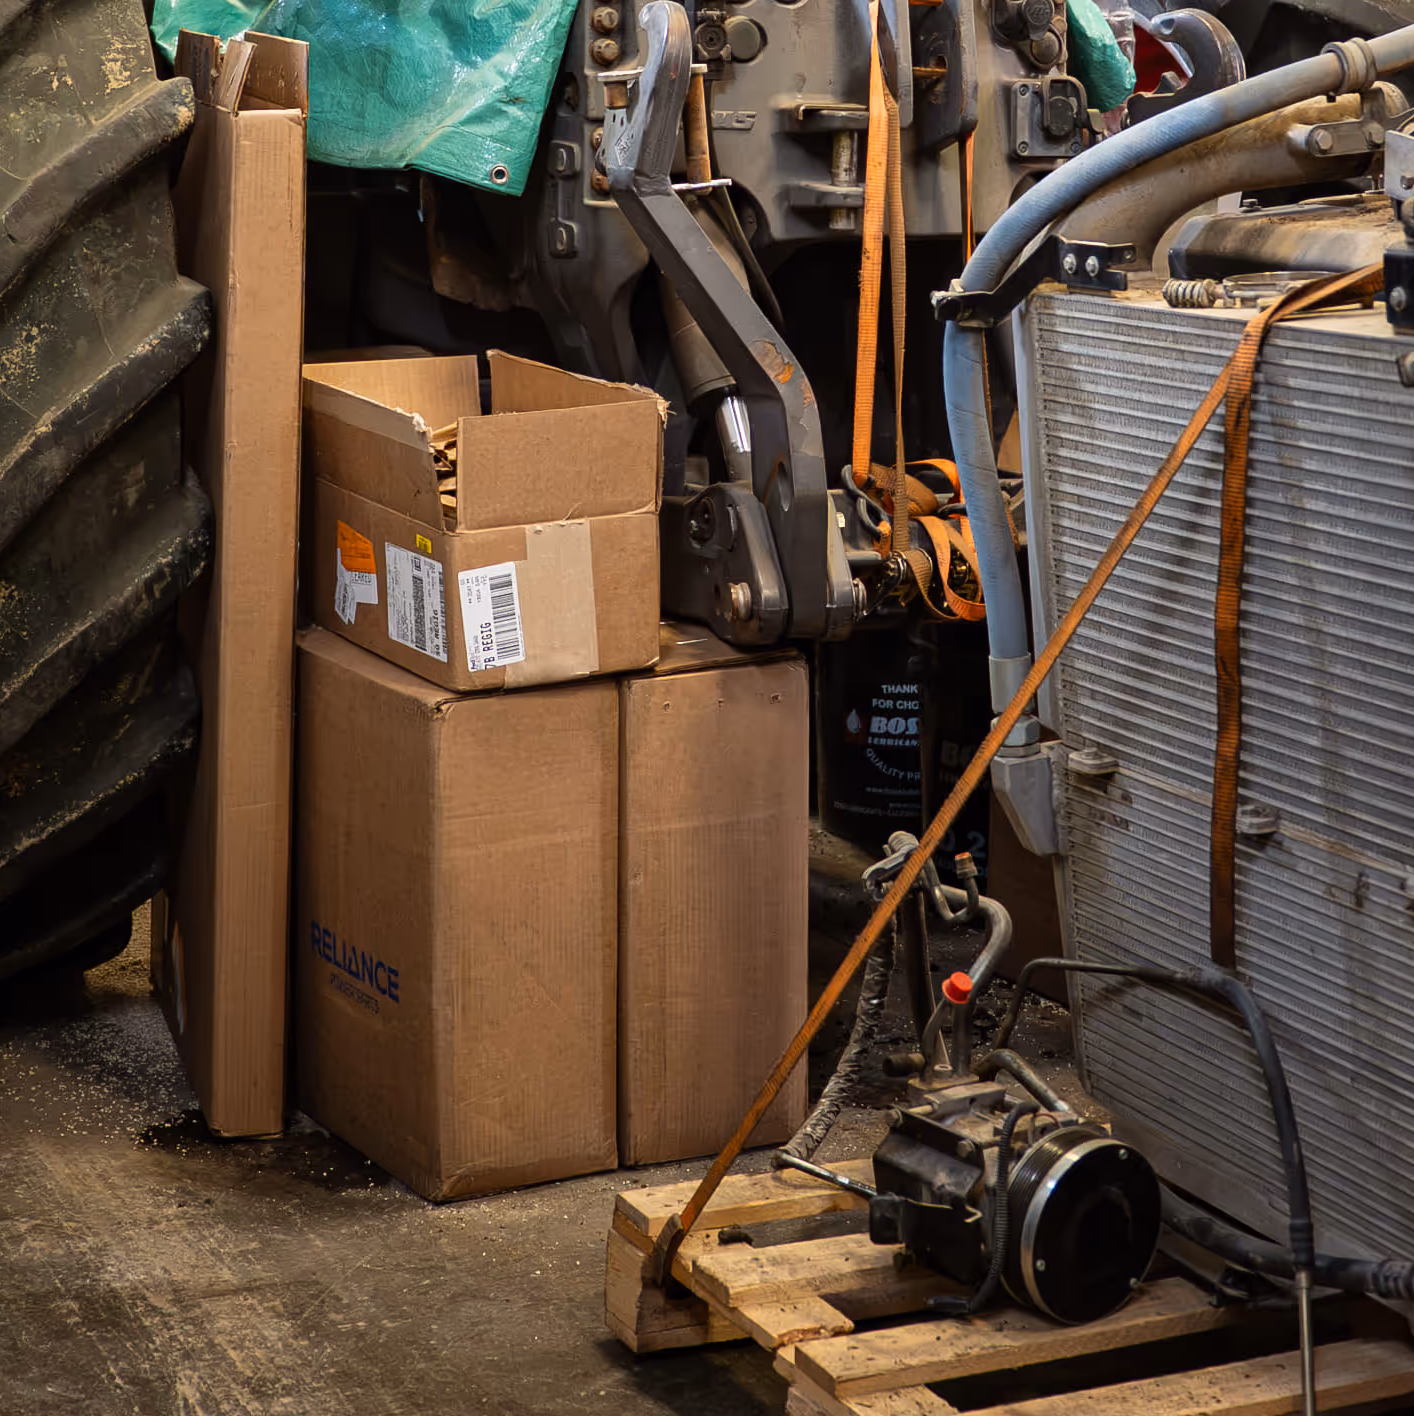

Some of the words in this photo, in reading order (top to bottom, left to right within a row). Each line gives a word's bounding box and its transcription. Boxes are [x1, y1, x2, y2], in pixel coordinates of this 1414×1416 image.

[480, 622, 494, 652] REGIG
[872, 698, 894, 709] FOR
[881, 684, 919, 694] THANK
[866, 747, 905, 780] QUALITY
[310, 919, 400, 1004] RELIANCE
